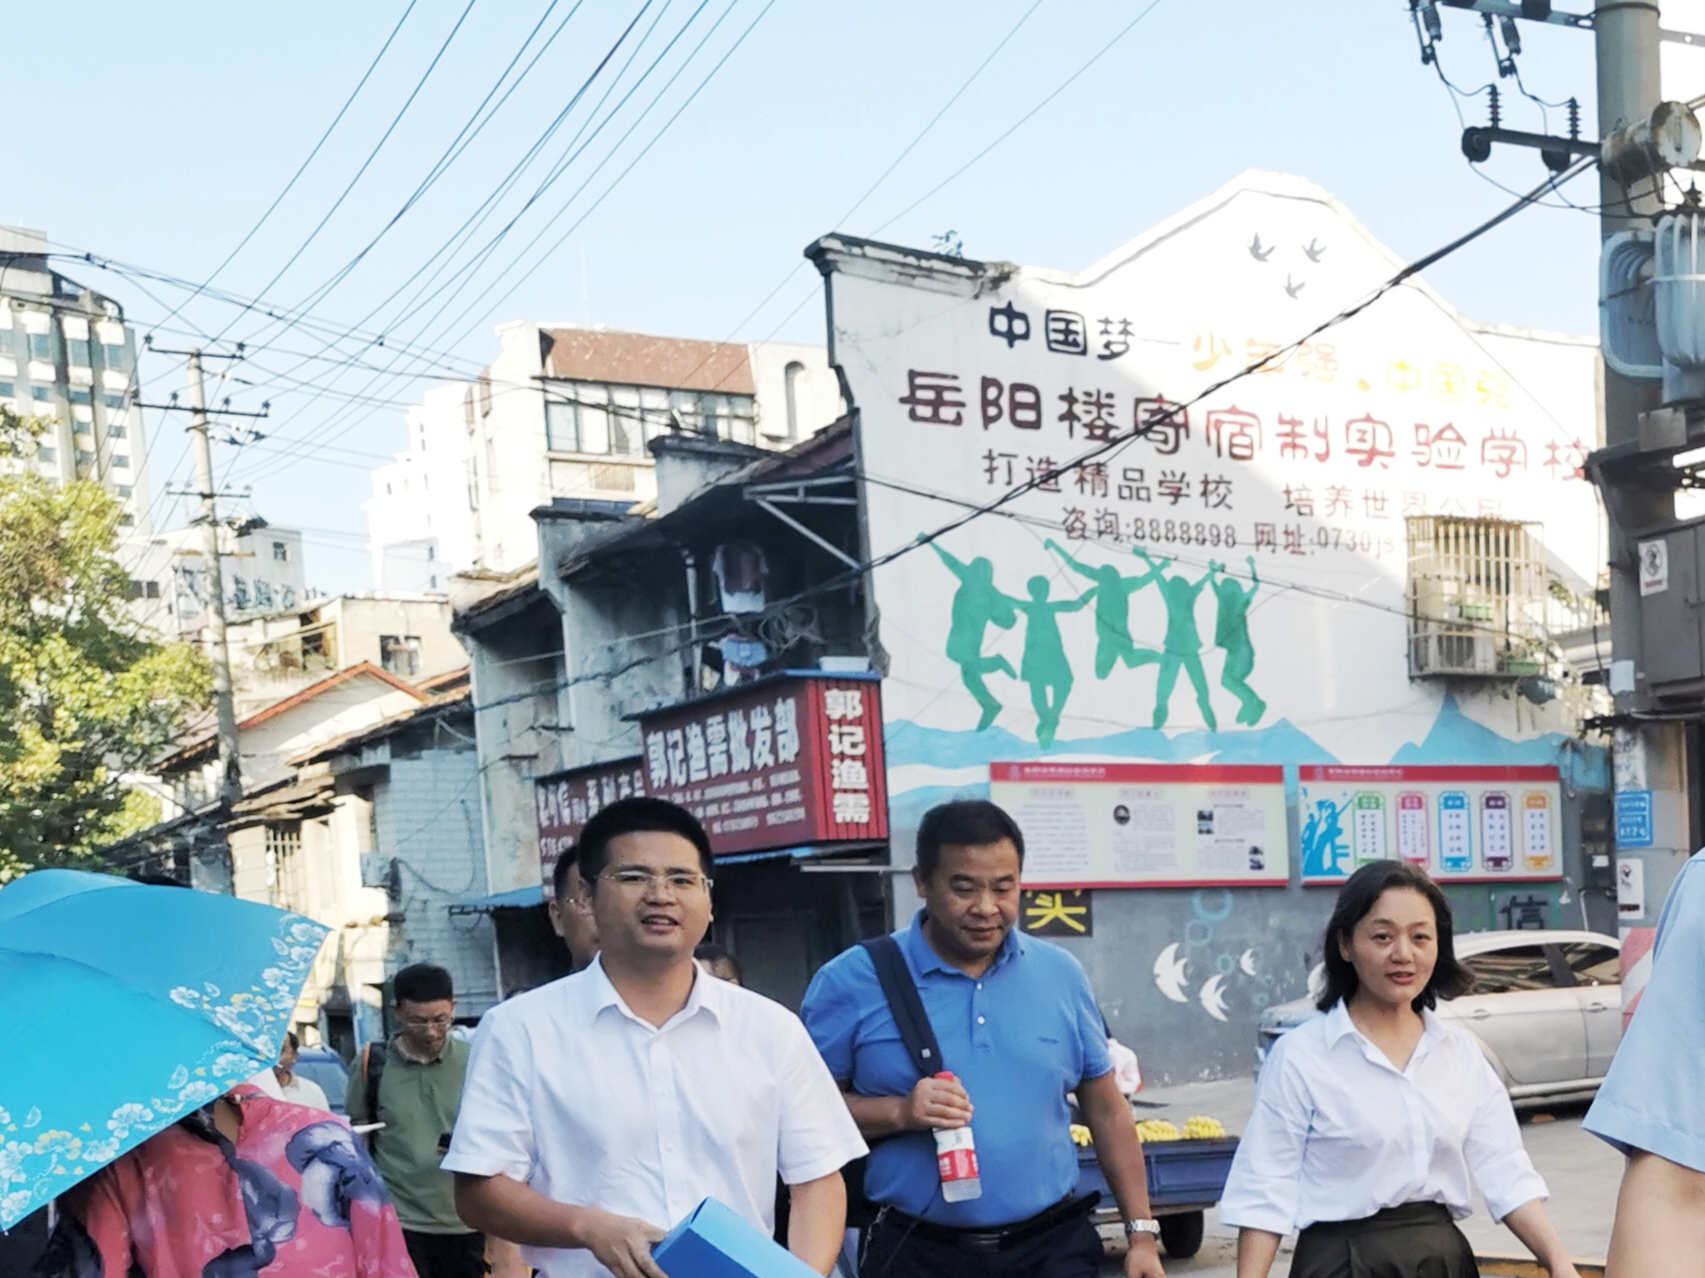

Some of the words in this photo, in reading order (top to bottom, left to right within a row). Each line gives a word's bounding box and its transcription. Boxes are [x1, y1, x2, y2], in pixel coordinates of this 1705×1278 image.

[988, 300, 1136, 361] 中国梦
[898, 368, 1592, 483] 岳阳楼寄宿制实验学校
[982, 448, 1235, 512] 打造精品学校
[823, 689, 870, 824] 郭记渔需
